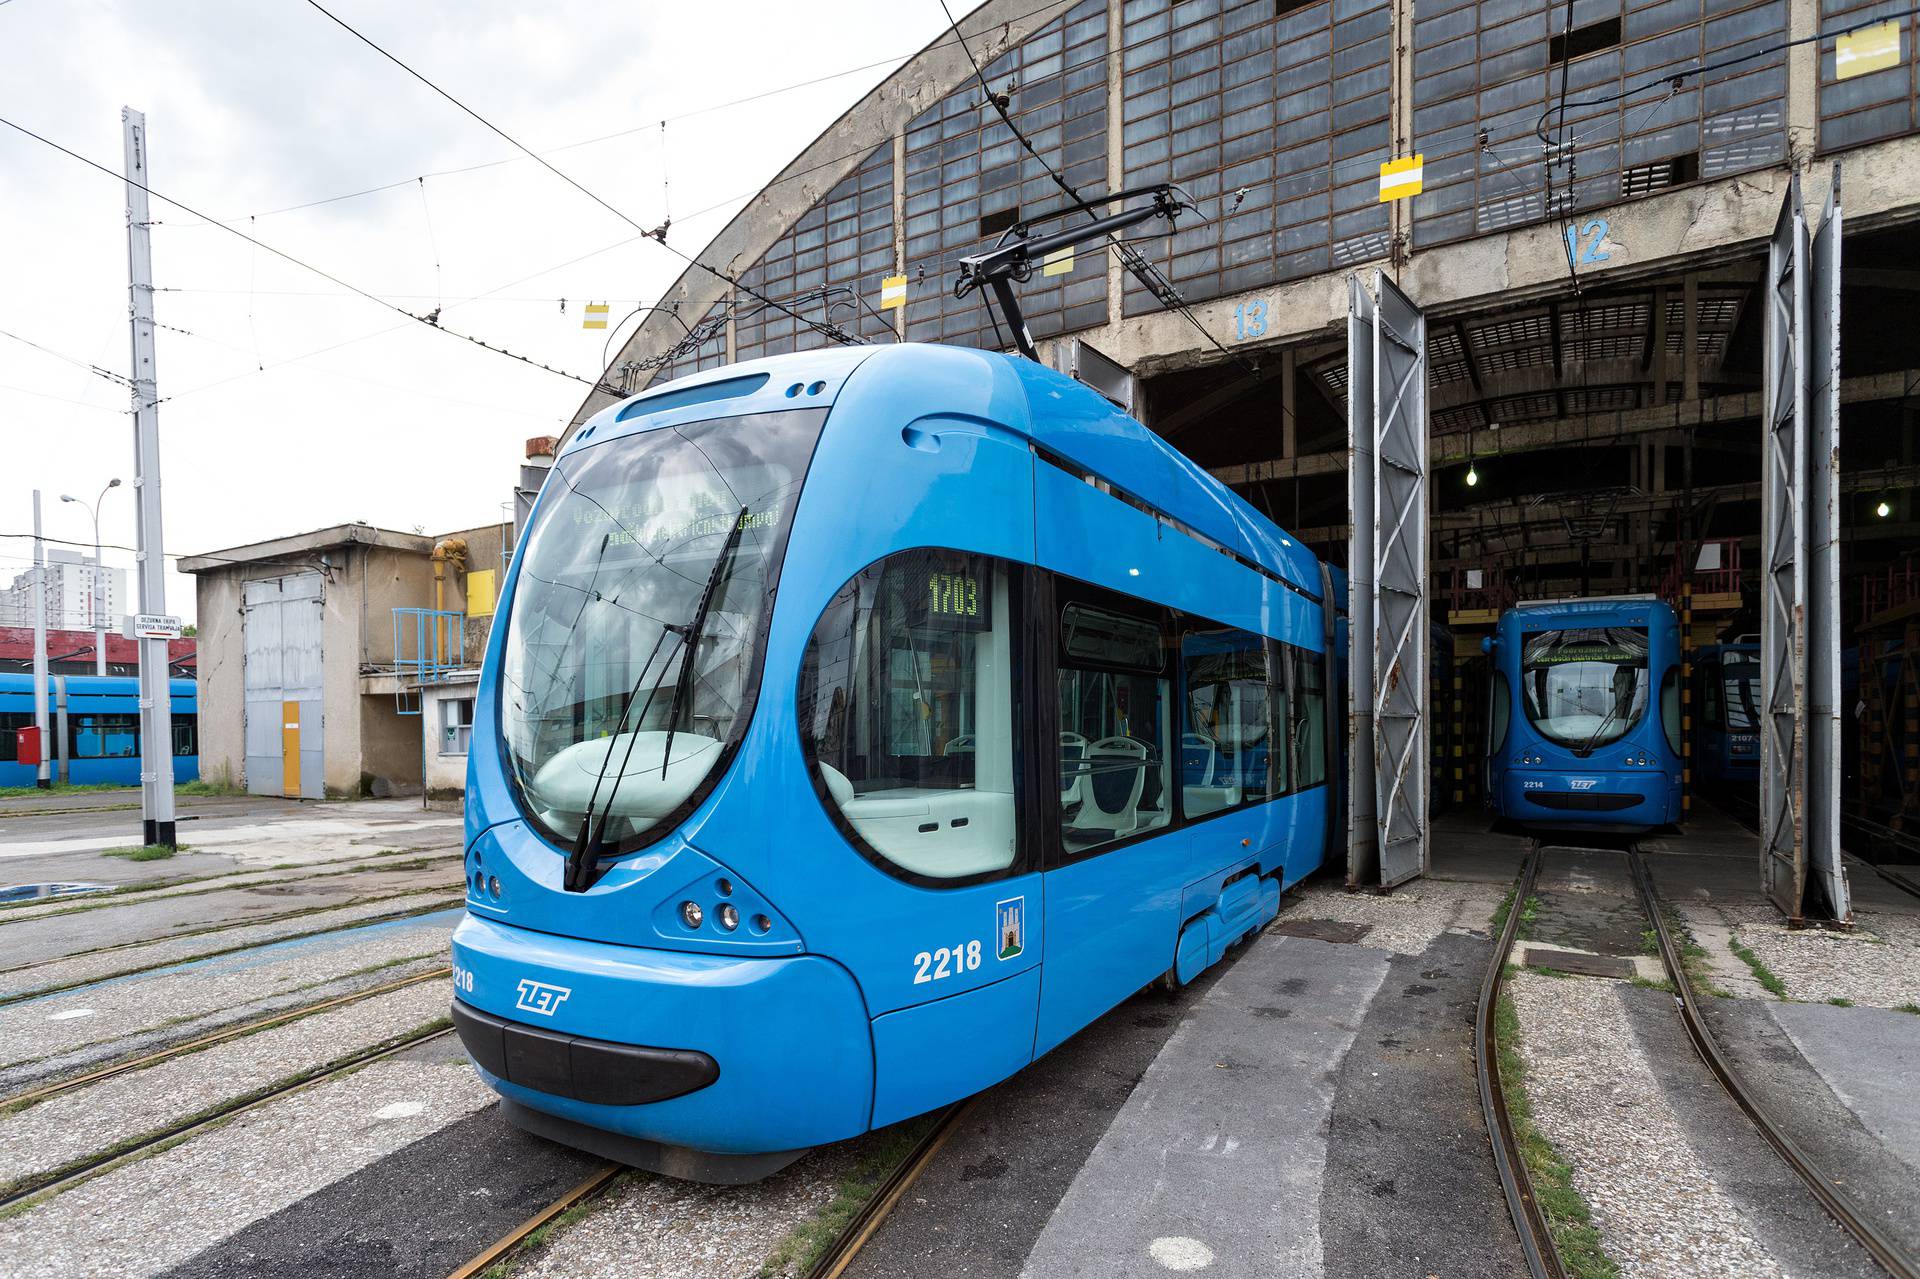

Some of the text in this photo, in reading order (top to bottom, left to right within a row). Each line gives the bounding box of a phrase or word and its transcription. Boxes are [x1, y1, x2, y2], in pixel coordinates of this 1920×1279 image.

[1564, 219, 1610, 270] 12
[1233, 299, 1268, 341] 13
[929, 573, 976, 616] 1703
[913, 939, 982, 985] 2218
[516, 978, 573, 1017] ZET
